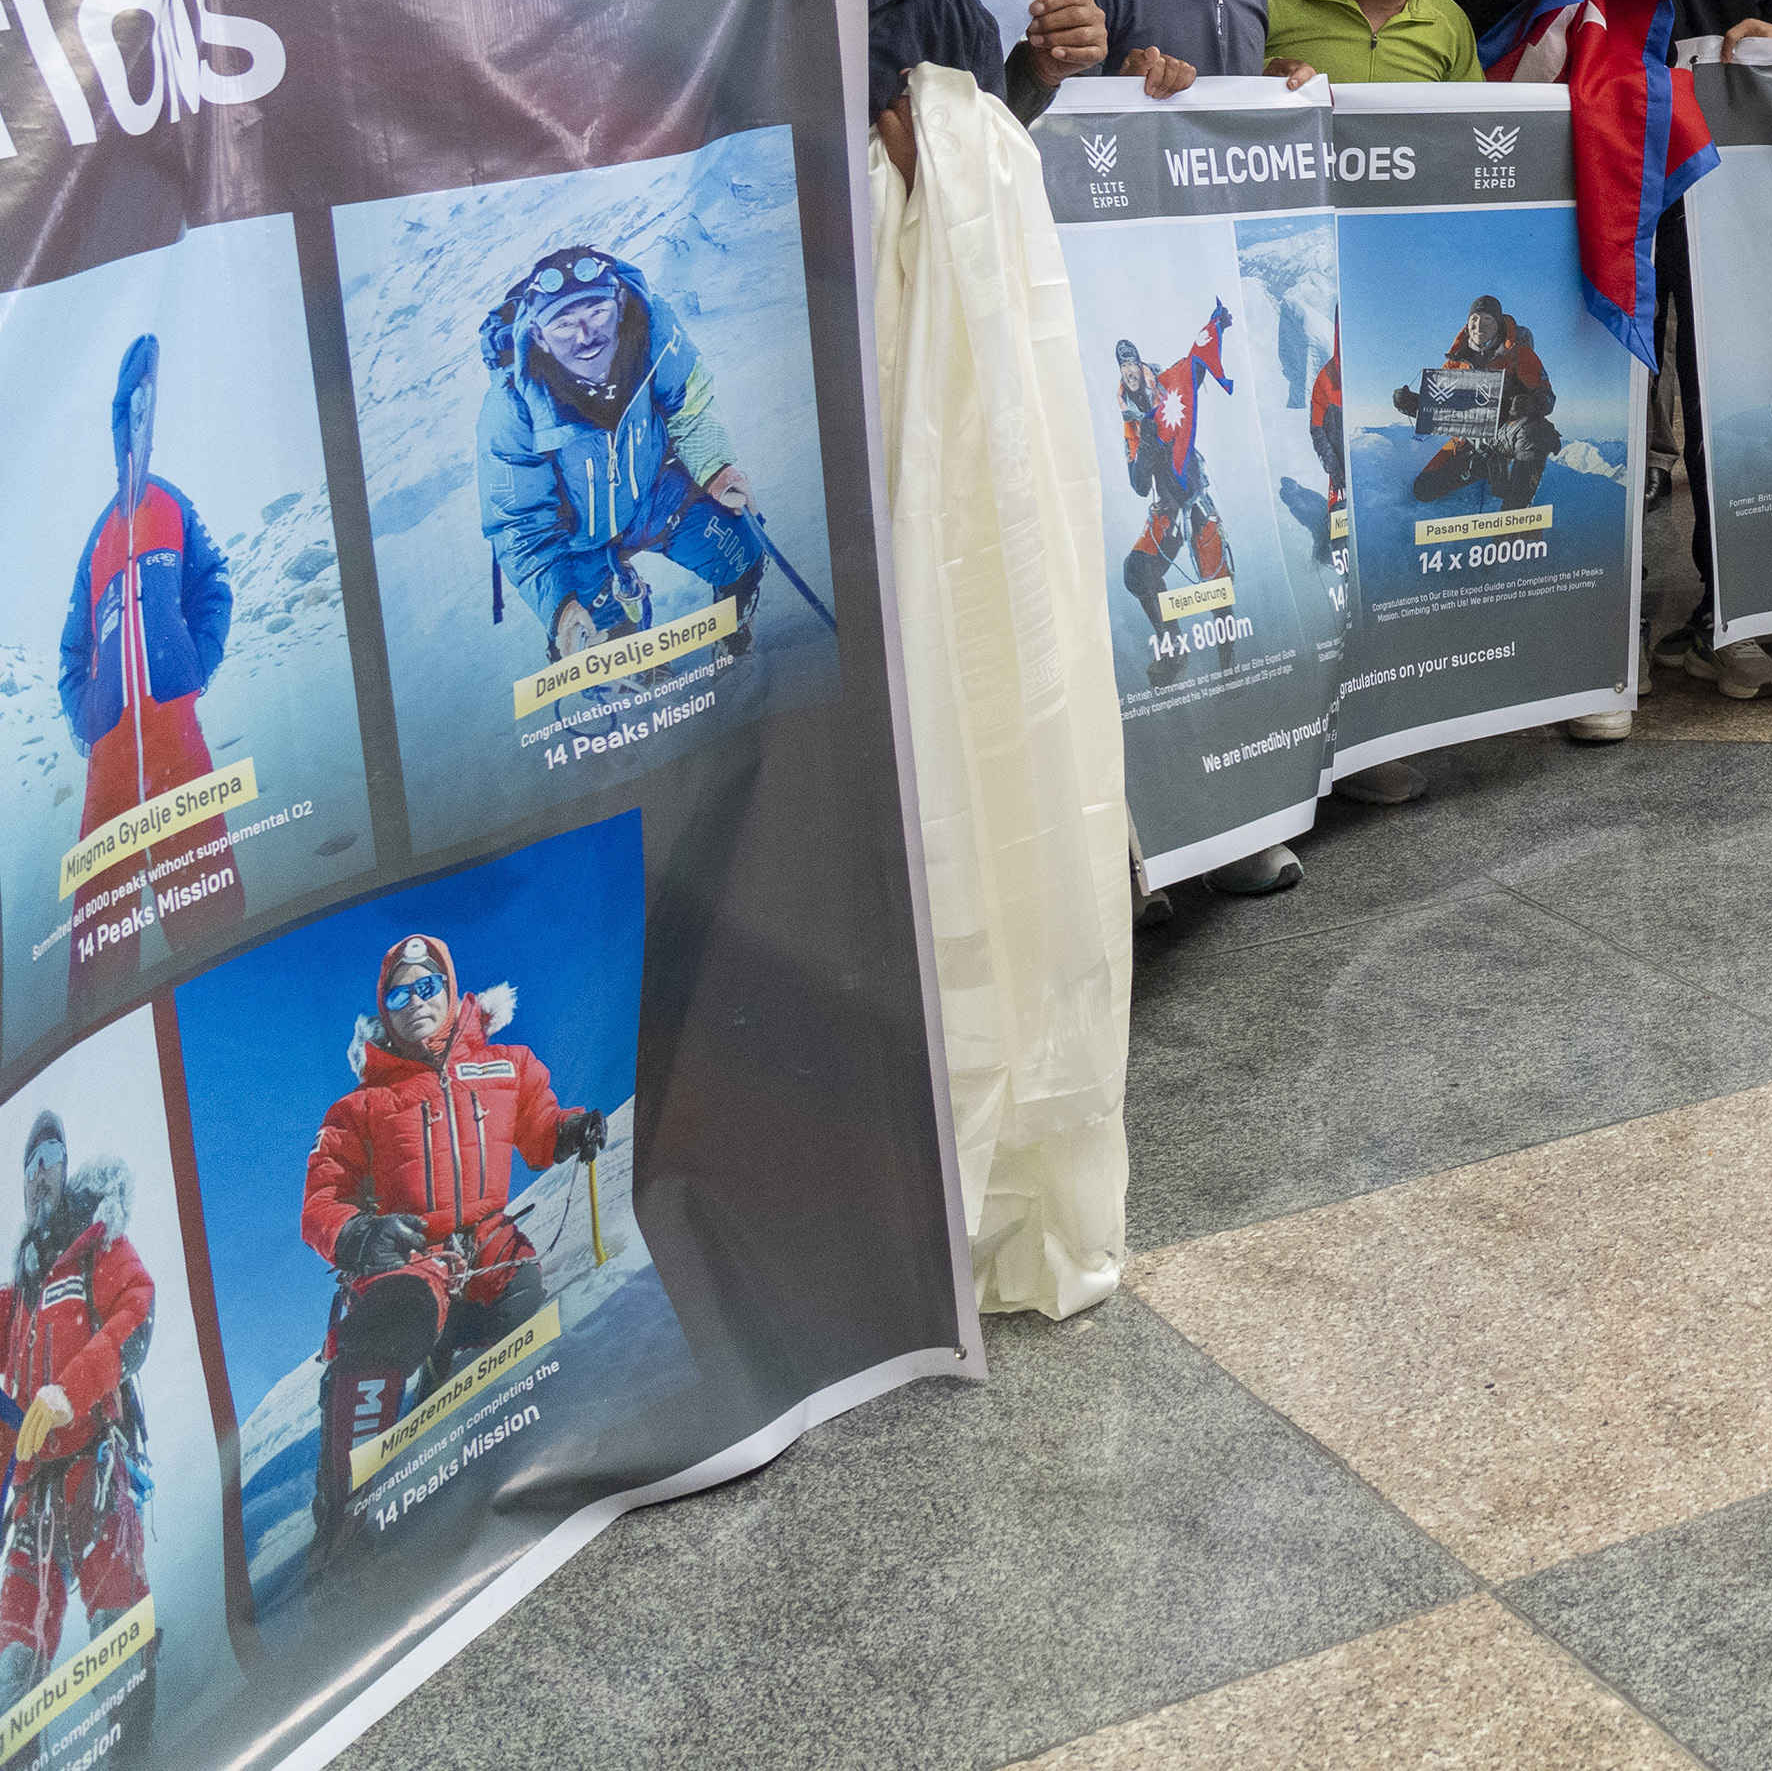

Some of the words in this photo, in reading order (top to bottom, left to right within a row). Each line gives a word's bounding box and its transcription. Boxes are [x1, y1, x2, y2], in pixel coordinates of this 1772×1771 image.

[1090, 181, 1126, 194] ELITE
[1093, 196, 1129, 209] EXPED
[1164, 142, 1317, 187] WELCOME
[1474, 166, 1516, 177] ELITE
[1474, 178, 1516, 189] EXPED
[1426, 522, 1469, 537] Pasang
[1472, 517, 1503, 532] Tendi
[1505, 512, 1542, 529] Sherpa
[1729, 496, 1755, 508] Former
[1418, 550, 1444, 575] 14
[1448, 552, 1463, 571] x
[1468, 539, 1548, 568] 8000m
[536, 665, 580, 698] Dawa
[586, 640, 654, 675] Gyalje
[658, 616, 717, 651] Sherpa
[1340, 665, 1397, 699] gratulations
[1399, 661, 1415, 679] on
[1417, 657, 1449, 678] your
[1451, 641, 1516, 668] success!
[521, 697, 631, 748] Congratulations
[634, 691, 652, 706] on
[654, 663, 715, 698] completing
[716, 654, 734, 669] the
[544, 743, 568, 770] 14
[573, 721, 650, 760] Peaks
[652, 690, 716, 734] Mission
[66, 835, 115, 883] Mingma
[119, 806, 172, 845] Gyalje
[175, 776, 243, 819] Sherpa
[72, 907, 86, 928] all
[85, 891, 110, 919] 8000
[111, 873, 147, 906] peaks
[148, 849, 195, 884] without
[196, 810, 290, 859] supplemental
[77, 937, 94, 964] 14
[97, 904, 155, 951] Peaks
[157, 867, 235, 918] Mission
[380, 1376, 473, 1459] Mingtemba
[477, 1328, 534, 1380] Sherpa
[353, 1437, 448, 1516] Congratulations
[449, 1426, 465, 1442] on
[466, 1376, 534, 1429] completing
[535, 1360, 560, 1379] the
[376, 1500, 399, 1531] 14
[402, 1458, 459, 1514] Peaks
[462, 1404, 541, 1467] Mission
[10, 1679, 68, 1740] Nurbu
[73, 1621, 140, 1686] Sherpa
[51, 1688, 125, 1756] completing
[127, 1668, 147, 1693] the
